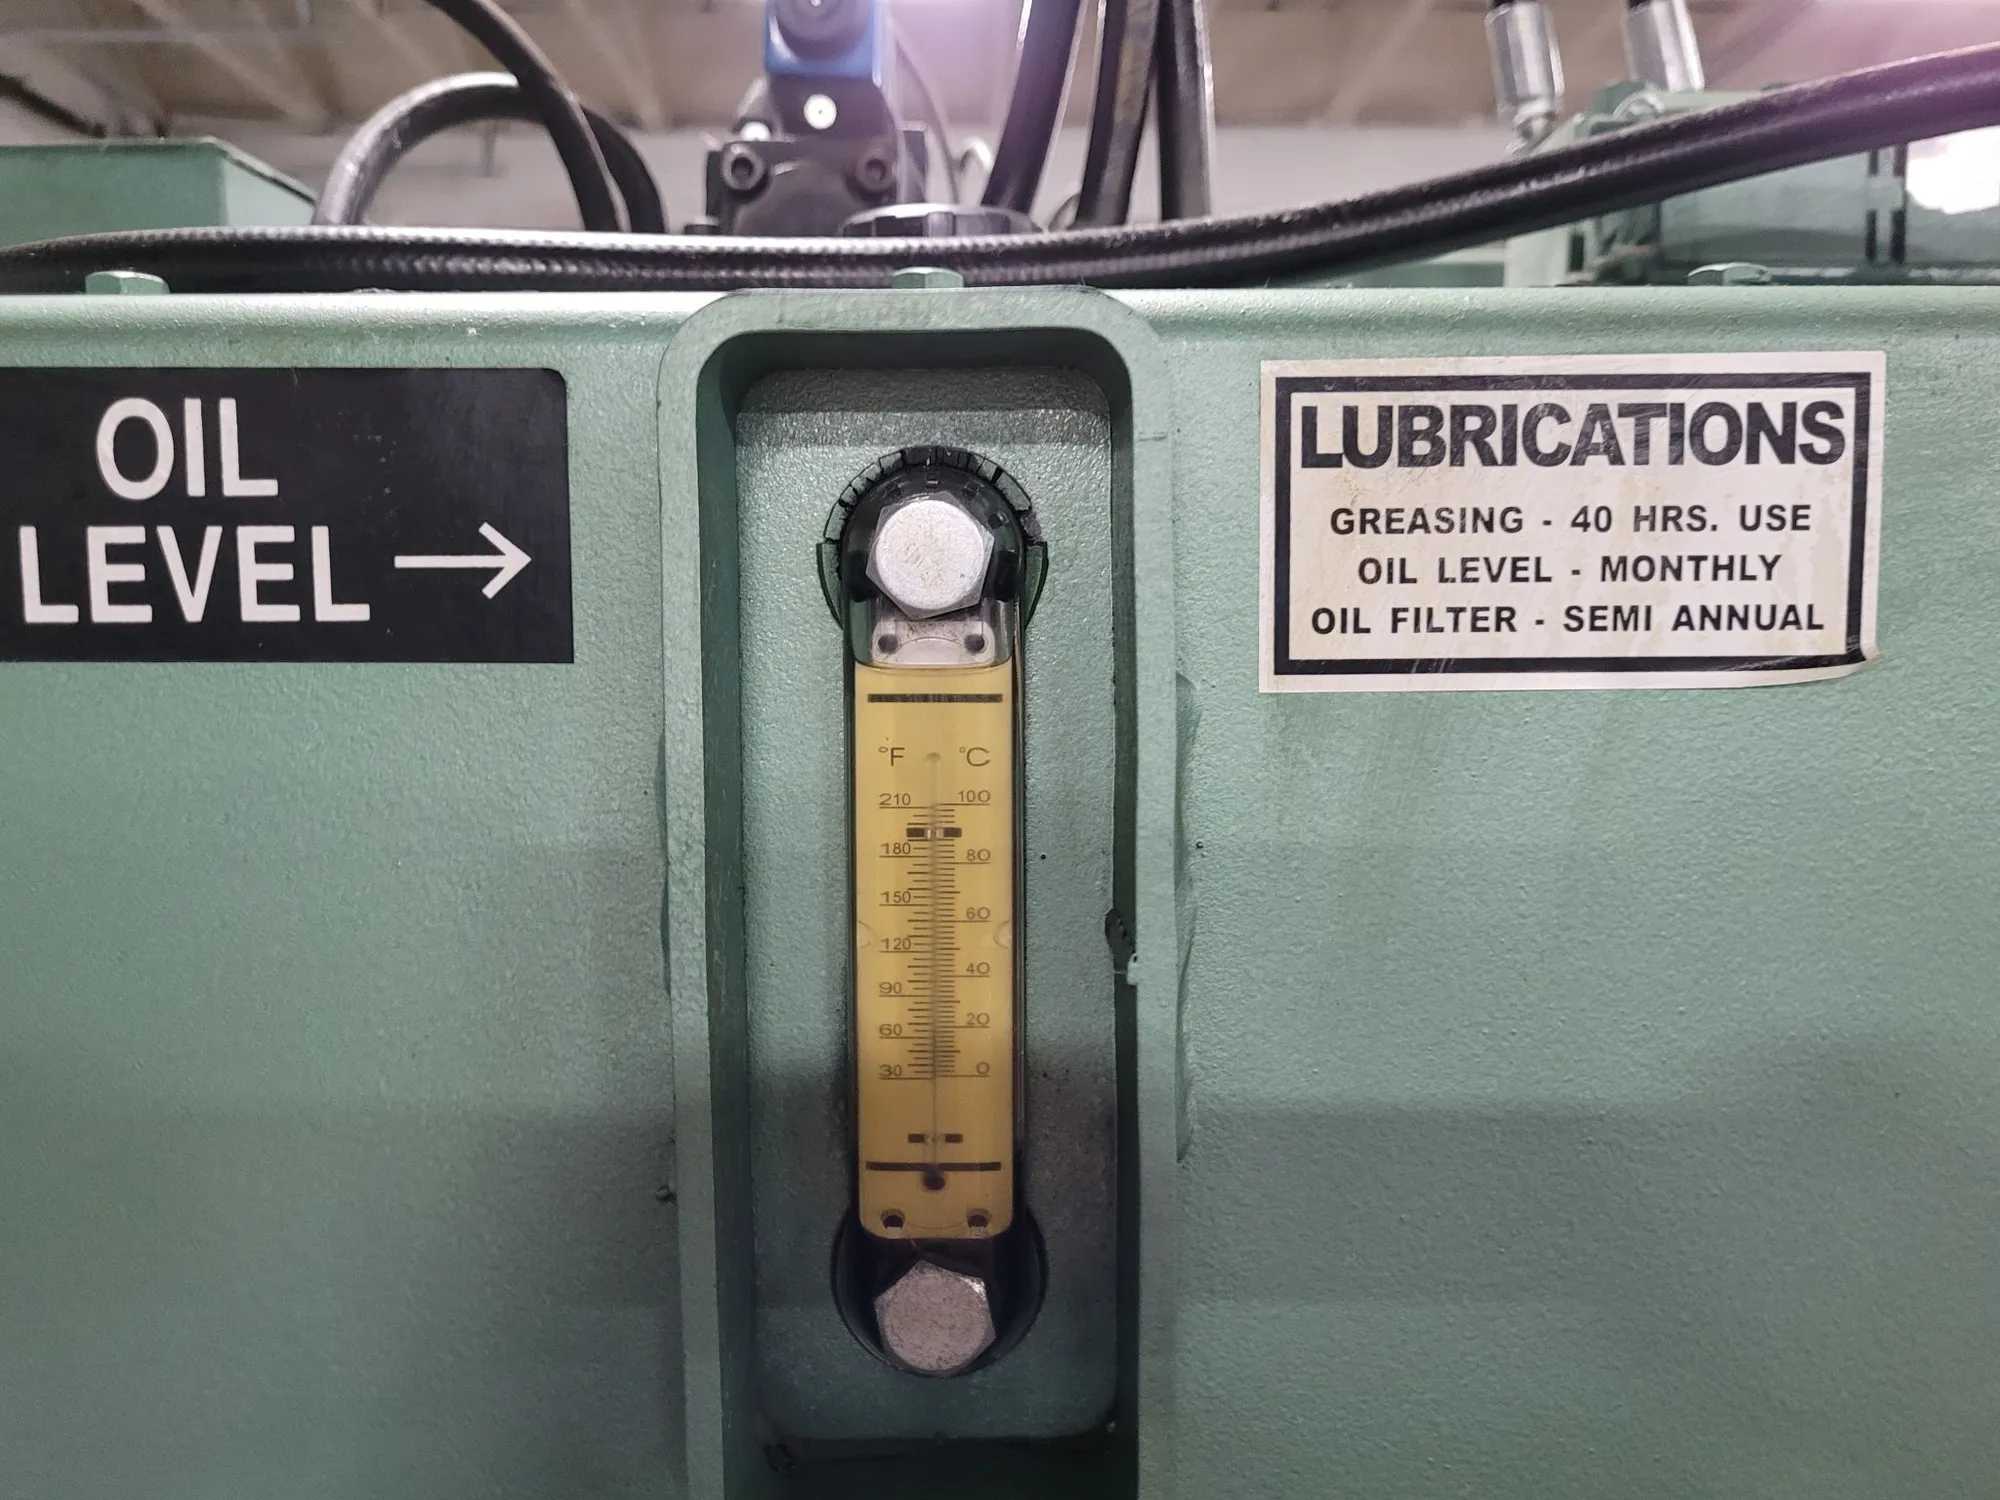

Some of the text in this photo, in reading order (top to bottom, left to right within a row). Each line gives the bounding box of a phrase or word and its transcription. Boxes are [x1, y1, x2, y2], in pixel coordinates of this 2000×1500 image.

[1301, 400, 1845, 469] LUBRICATIONS
[96, 397, 279, 500] OIL
[1330, 505, 1524, 535] GREASING
[1571, 505, 1613, 533] 40
[1634, 504, 1718, 533] HRS.
[1740, 504, 1812, 532] USE
[19, 524, 371, 624] LEVEL
[1357, 557, 1417, 585] OIL
[1439, 556, 1553, 584] LEVEL
[1601, 553, 1782, 583] MONTHLY
[1311, 606, 1371, 635] OIL
[1391, 605, 1517, 633] FILTER
[1564, 604, 1652, 633] SEMI
[1672, 602, 1825, 632] ANNUAL
[878, 746, 905, 767] °F
[959, 746, 991, 767] °C
[879, 793, 912, 807] 210
[958, 790, 991, 803] 100
[881, 842, 912, 855] 180
[966, 848, 991, 862] 80
[881, 891, 912, 904] 150
[966, 906, 991, 920] 60
[883, 938, 911, 950] 120
[966, 962, 991, 974] 40
[879, 982, 903, 995] 90
[966, 1012, 991, 1025] 20
[879, 1024, 903, 1036] 60
[879, 1064, 903, 1077] 30
[976, 1062, 990, 1075] 0
